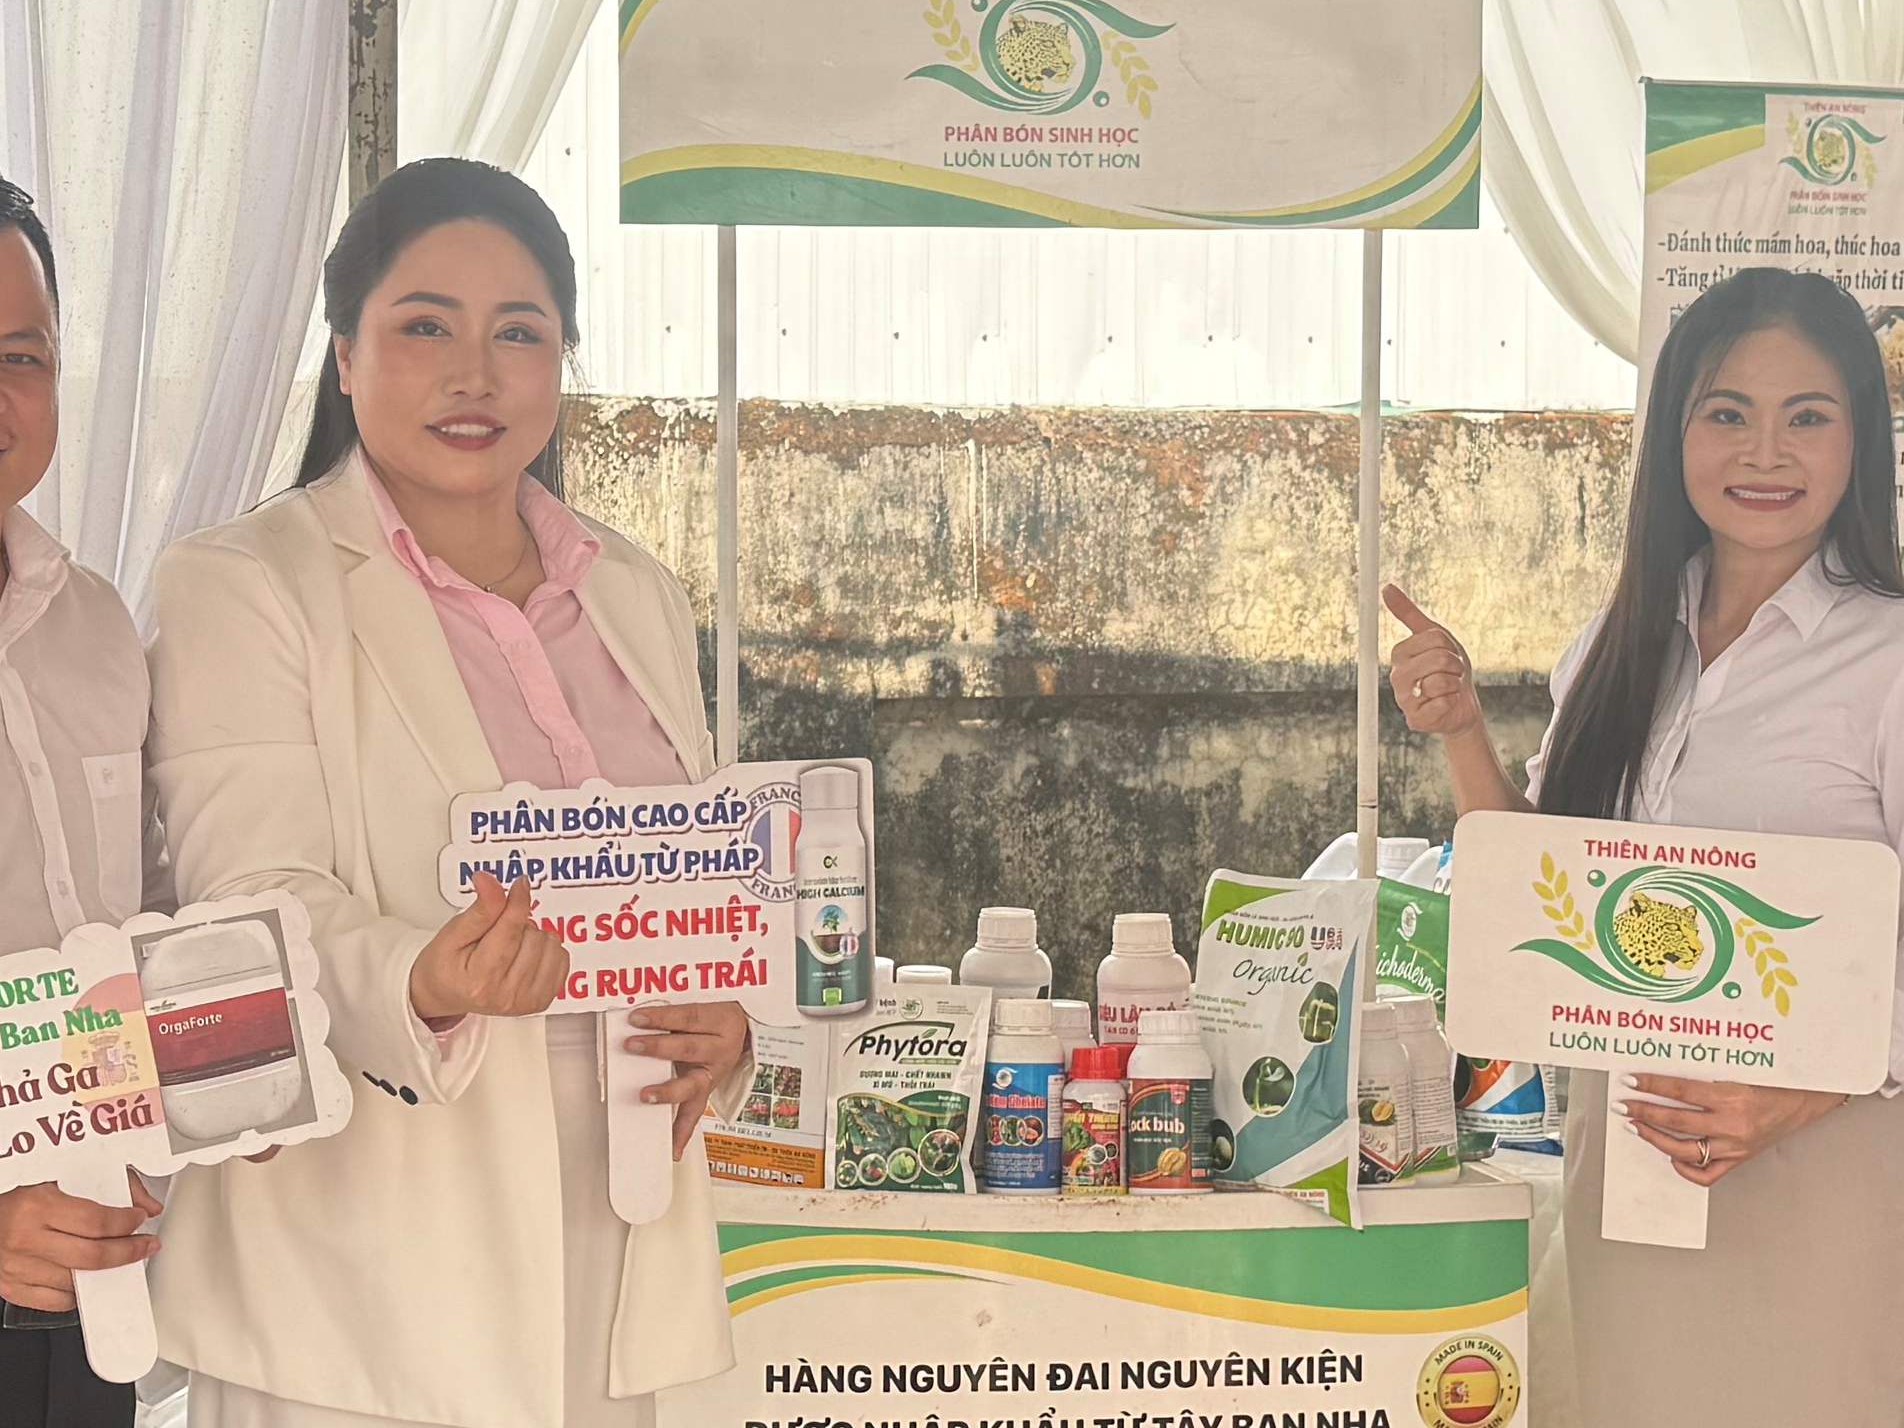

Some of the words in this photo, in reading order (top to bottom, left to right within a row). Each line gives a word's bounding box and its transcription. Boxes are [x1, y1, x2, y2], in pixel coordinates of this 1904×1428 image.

[945, 124, 997, 142] PHÂN
[1003, 124, 1043, 142] BÓN
[1049, 127, 1092, 143] SINH
[1098, 127, 1139, 147] HỌC
[944, 150, 995, 167] LUÔN
[1001, 150, 1051, 167] LUÔN
[1099, 153, 1140, 168] HƠN
[1871, 236, 1900, 256] hoa
[1855, 270, 1887, 290] thời
[471, 800, 555, 836] PHÂN
[563, 796, 627, 832] BÓN
[632, 802, 689, 828] CAO
[694, 786, 748, 825] CẤP
[551, 842, 636, 880] KHẨU
[688, 840, 760, 871] PHÁP
[1584, 839, 1649, 860] THIÊN
[1653, 845, 1686, 864] AN
[1690, 845, 1757, 869] NÔNG
[594, 894, 658, 943] SỐC
[596, 963, 690, 1004] RỤNG
[695, 947, 768, 988] TRÁI
[1232, 959, 1315, 996] Organic
[0, 1017, 59, 1053] Ban
[65, 1004, 123, 1037] Nha
[159, 1013, 223, 1035] OrgaForte
[1552, 1004, 1611, 1026] PHÂN
[1617, 1009, 1664, 1031] BÓN
[1669, 1016, 1721, 1036] SINH
[1727, 1021, 1774, 1044] HỌC
[858, 1034, 968, 1061] Phytora
[1549, 1031, 1607, 1052] LUÔN
[1613, 1038, 1672, 1058] LUÔN
[1726, 1049, 1775, 1068] HƠN
[48, 1062, 101, 1096] Ga
[90, 1091, 154, 1134] Giá
[1153, 1118, 1185, 1135] bub
[764, 1357, 873, 1394] HÀNG
[882, 1360, 1037, 1393] NGUYÊN
[1045, 1363, 1110, 1390] ĐAI
[1120, 1353, 1278, 1390] NGUYÊN
[1289, 1348, 1364, 1395] KIỆN
